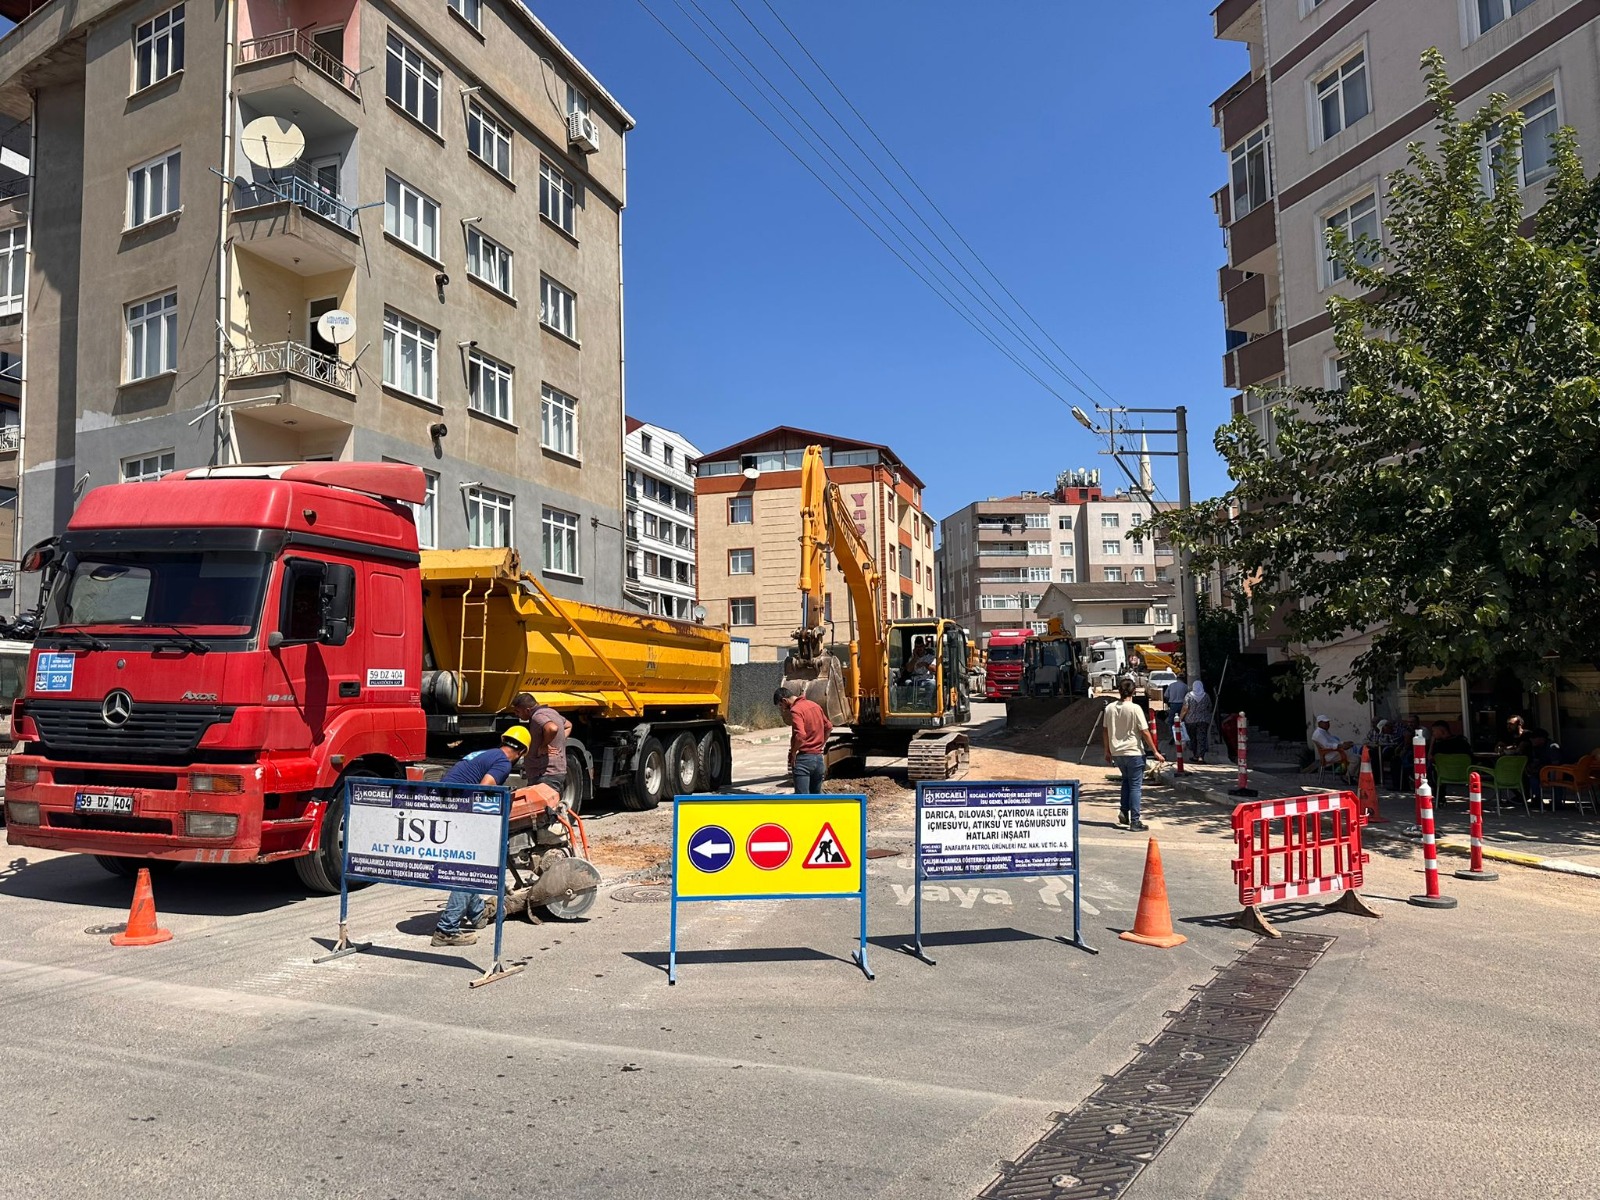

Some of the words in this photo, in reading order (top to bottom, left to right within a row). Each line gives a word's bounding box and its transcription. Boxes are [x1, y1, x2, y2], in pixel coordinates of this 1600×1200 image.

[52, 675, 67, 683] 2024
[370, 671, 379, 679] 59
[380, 671, 390, 679] DZ
[391, 671, 402, 679] 404
[182, 690, 217, 701] AXOR
[81, 795, 92, 806] 59
[98, 796, 109, 808] DZ
[114, 798, 131, 810] 404
[925, 810, 957, 820] DARICA,
[958, 809, 996, 819] DİLOVASI,
[997, 808, 1035, 820] ÇAYIROVA
[1036, 808, 1069, 819] İLÇELERİ
[394, 811, 451, 845] İSU
[927, 821, 971, 832] İÇMESUYU,
[972, 820, 1001, 830] ATIKSU
[1002, 820, 1013, 829] VE
[1015, 818, 1066, 828] YAĞMURSUYU
[966, 831, 999, 840] HATLARI
[1000, 830, 1031, 841] İNŞAATI
[371, 843, 389, 853] ALT
[392, 845, 415, 855] YAPI
[418, 847, 476, 860] ÇALIŞMASI
[944, 844, 971, 852] ANAFARTA
[971, 843, 991, 851] PETROL
[991, 841, 1016, 850] ÜRÜNLERİ
[890, 884, 1013, 909] yaya
